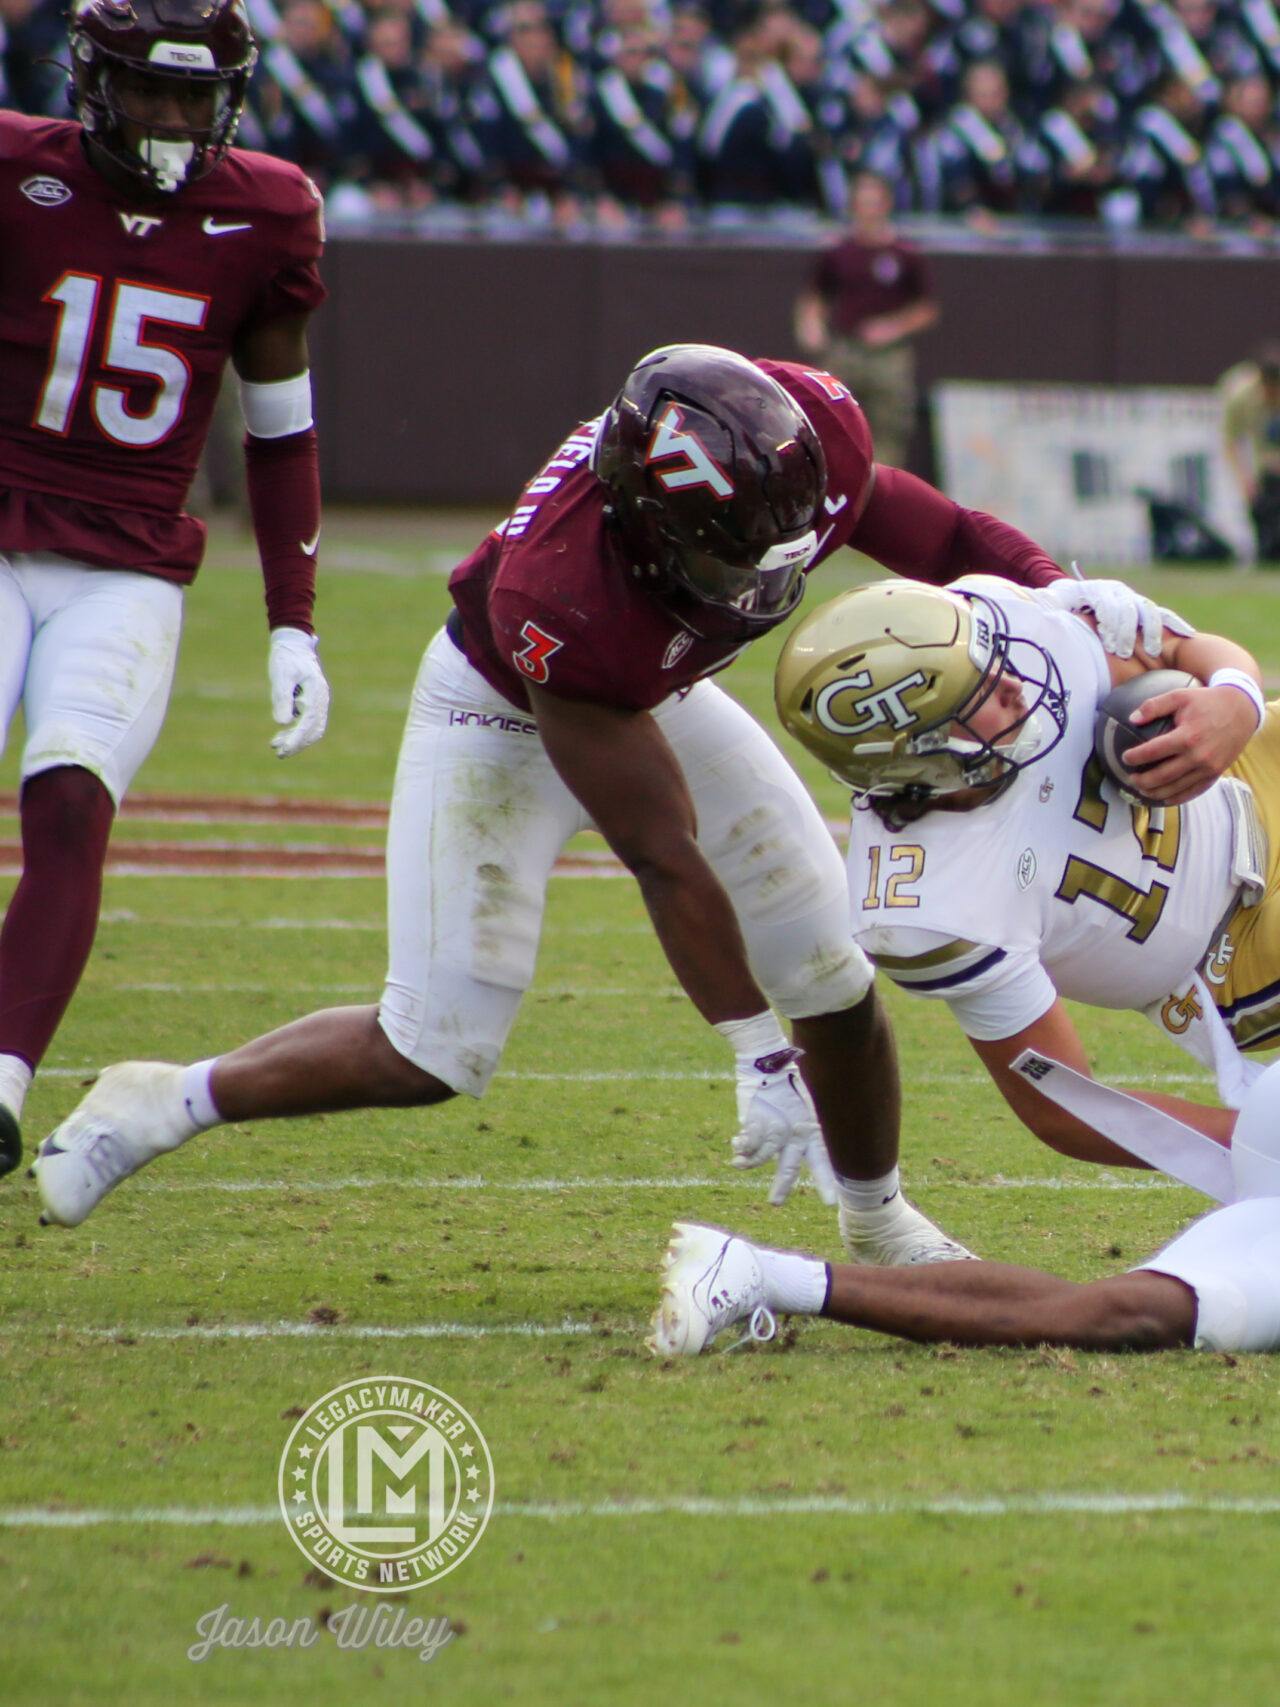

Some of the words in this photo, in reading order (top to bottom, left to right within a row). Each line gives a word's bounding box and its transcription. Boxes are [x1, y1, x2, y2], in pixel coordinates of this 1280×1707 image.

[170, 51, 203, 63] TECH
[119, 211, 163, 237] VT
[33, 270, 211, 449] 15
[512, 620, 565, 684] 3
[816, 669, 927, 736] GT
[862, 844, 926, 911] 12
[1161, 984, 1204, 1035] GT
